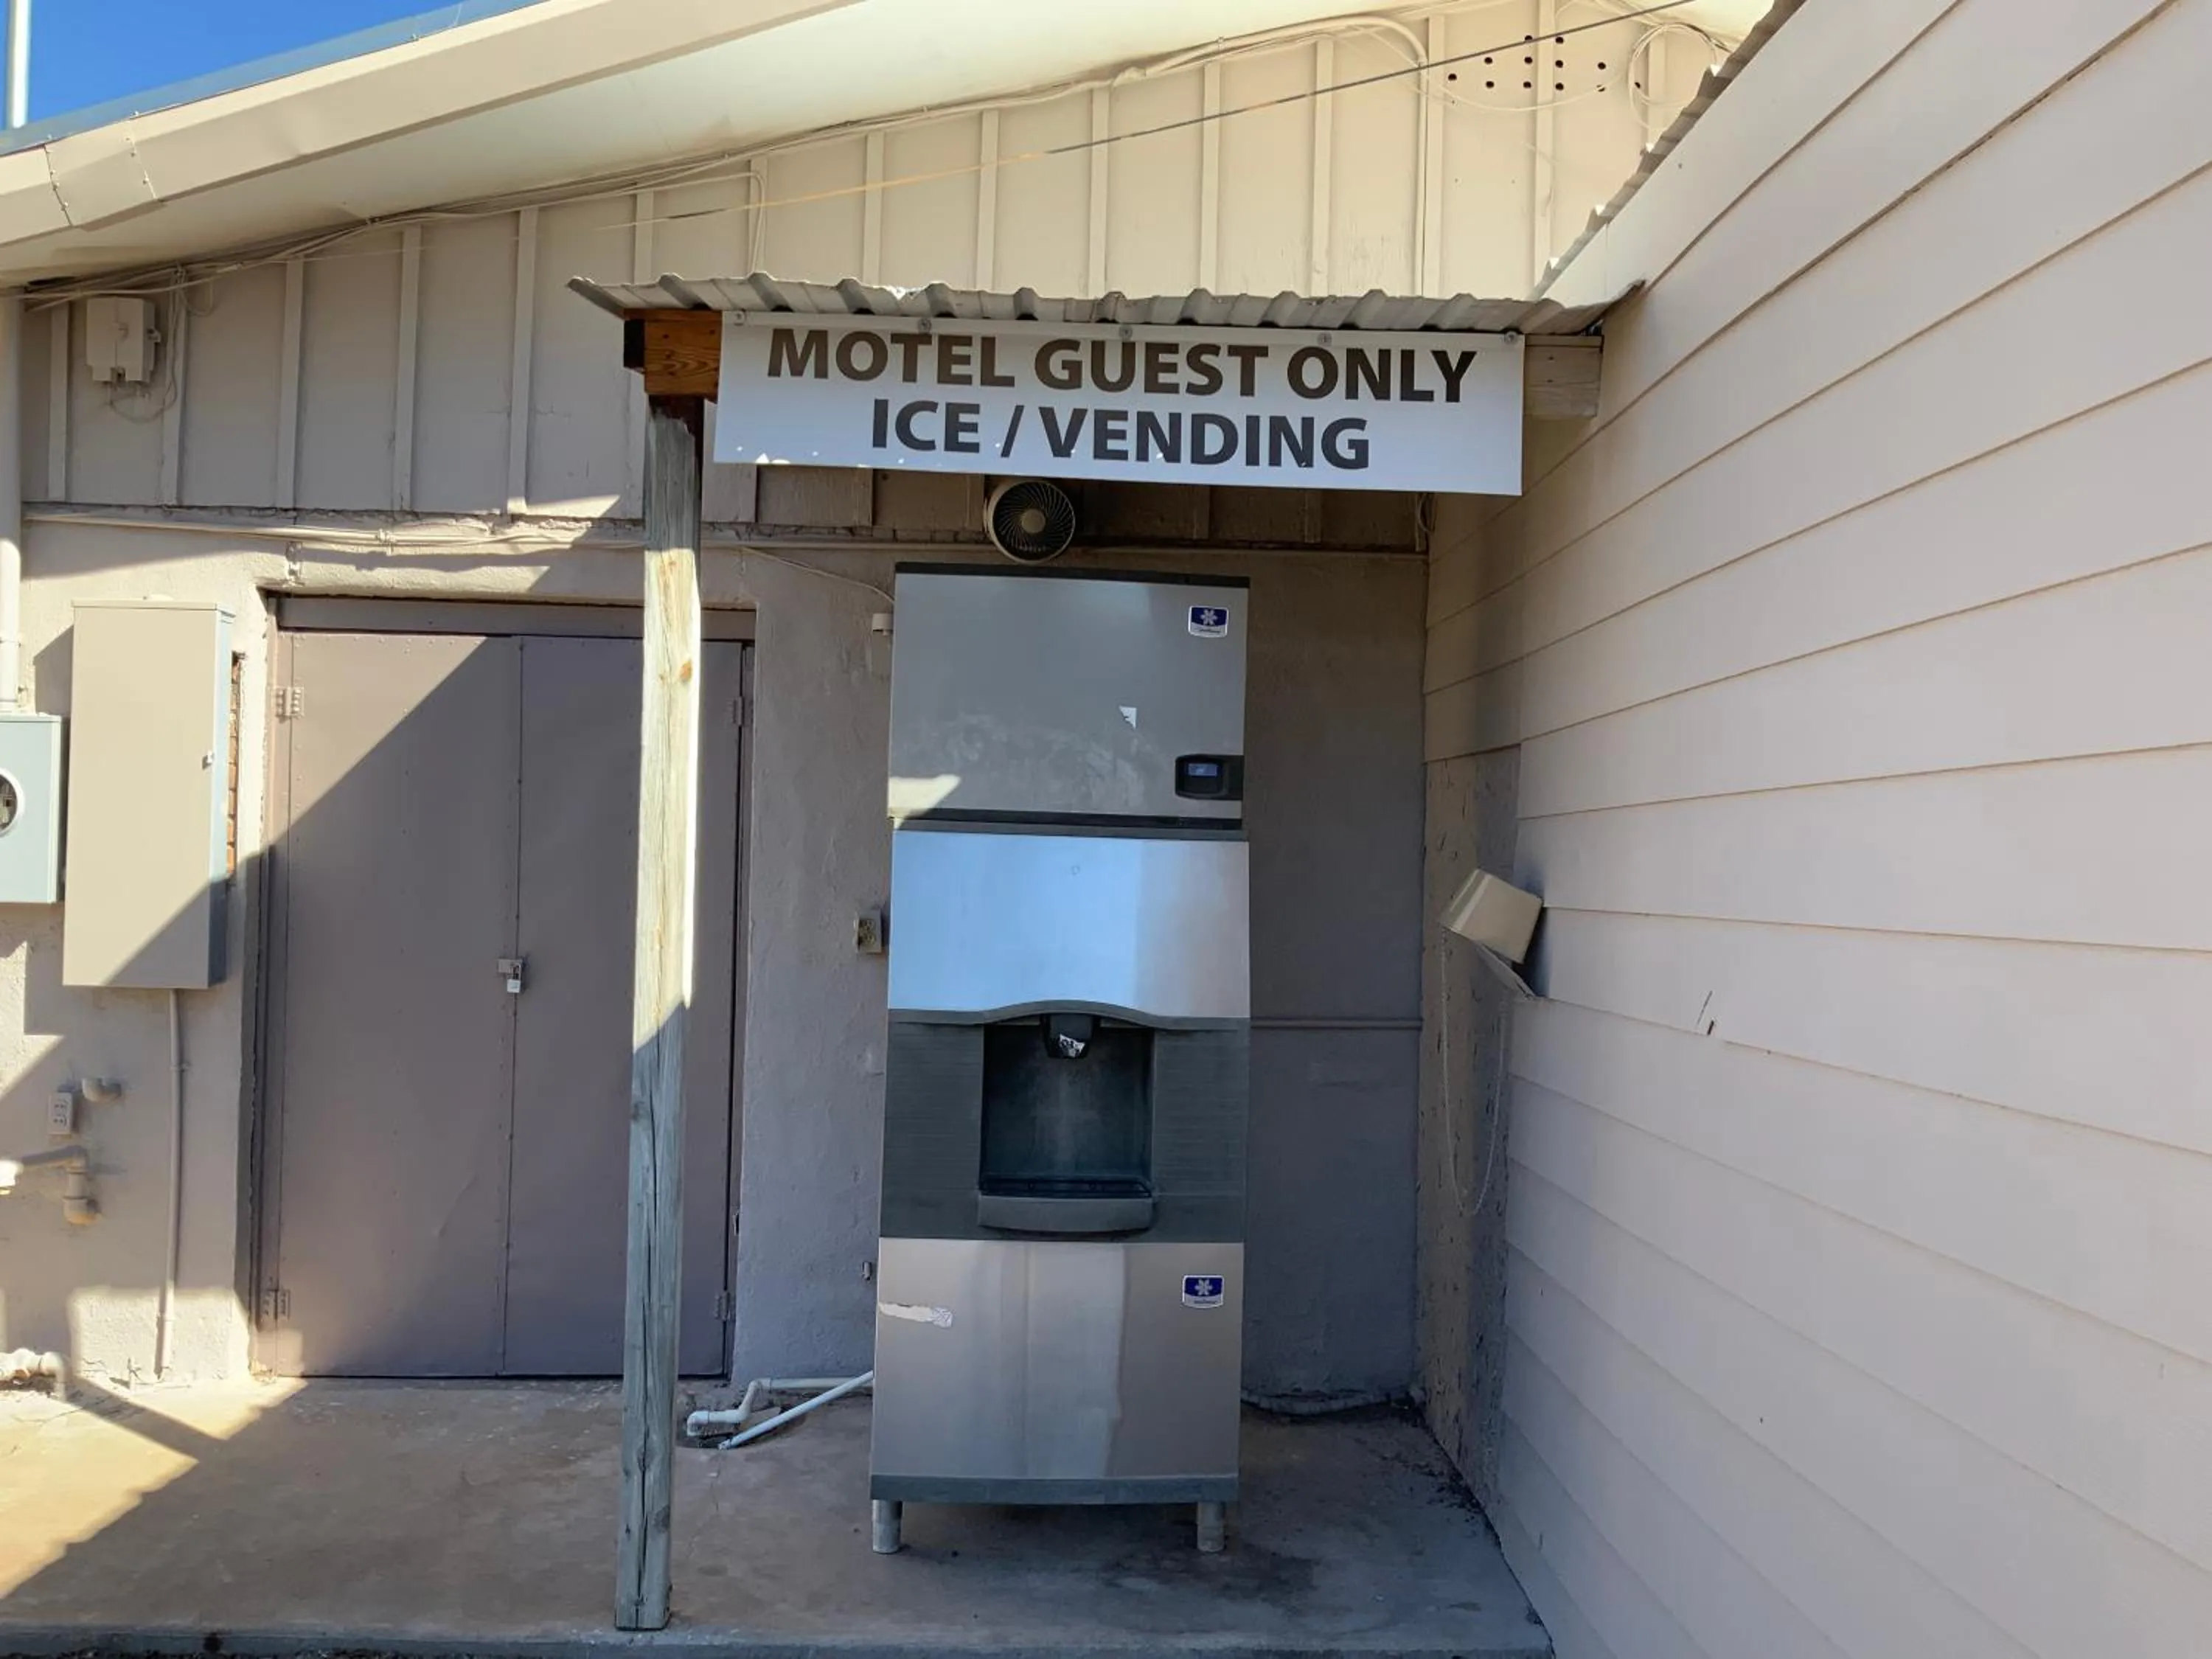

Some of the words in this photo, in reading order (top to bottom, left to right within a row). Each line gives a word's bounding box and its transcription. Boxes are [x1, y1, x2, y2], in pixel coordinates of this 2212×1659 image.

[766, 327, 1016, 388] MOTEL
[1034, 338, 1270, 397] GUEST
[1287, 345, 1478, 403] ONLY
[872, 398, 981, 453] ICE
[1001, 405, 1025, 458] /
[1037, 406, 1370, 470] VENDING
